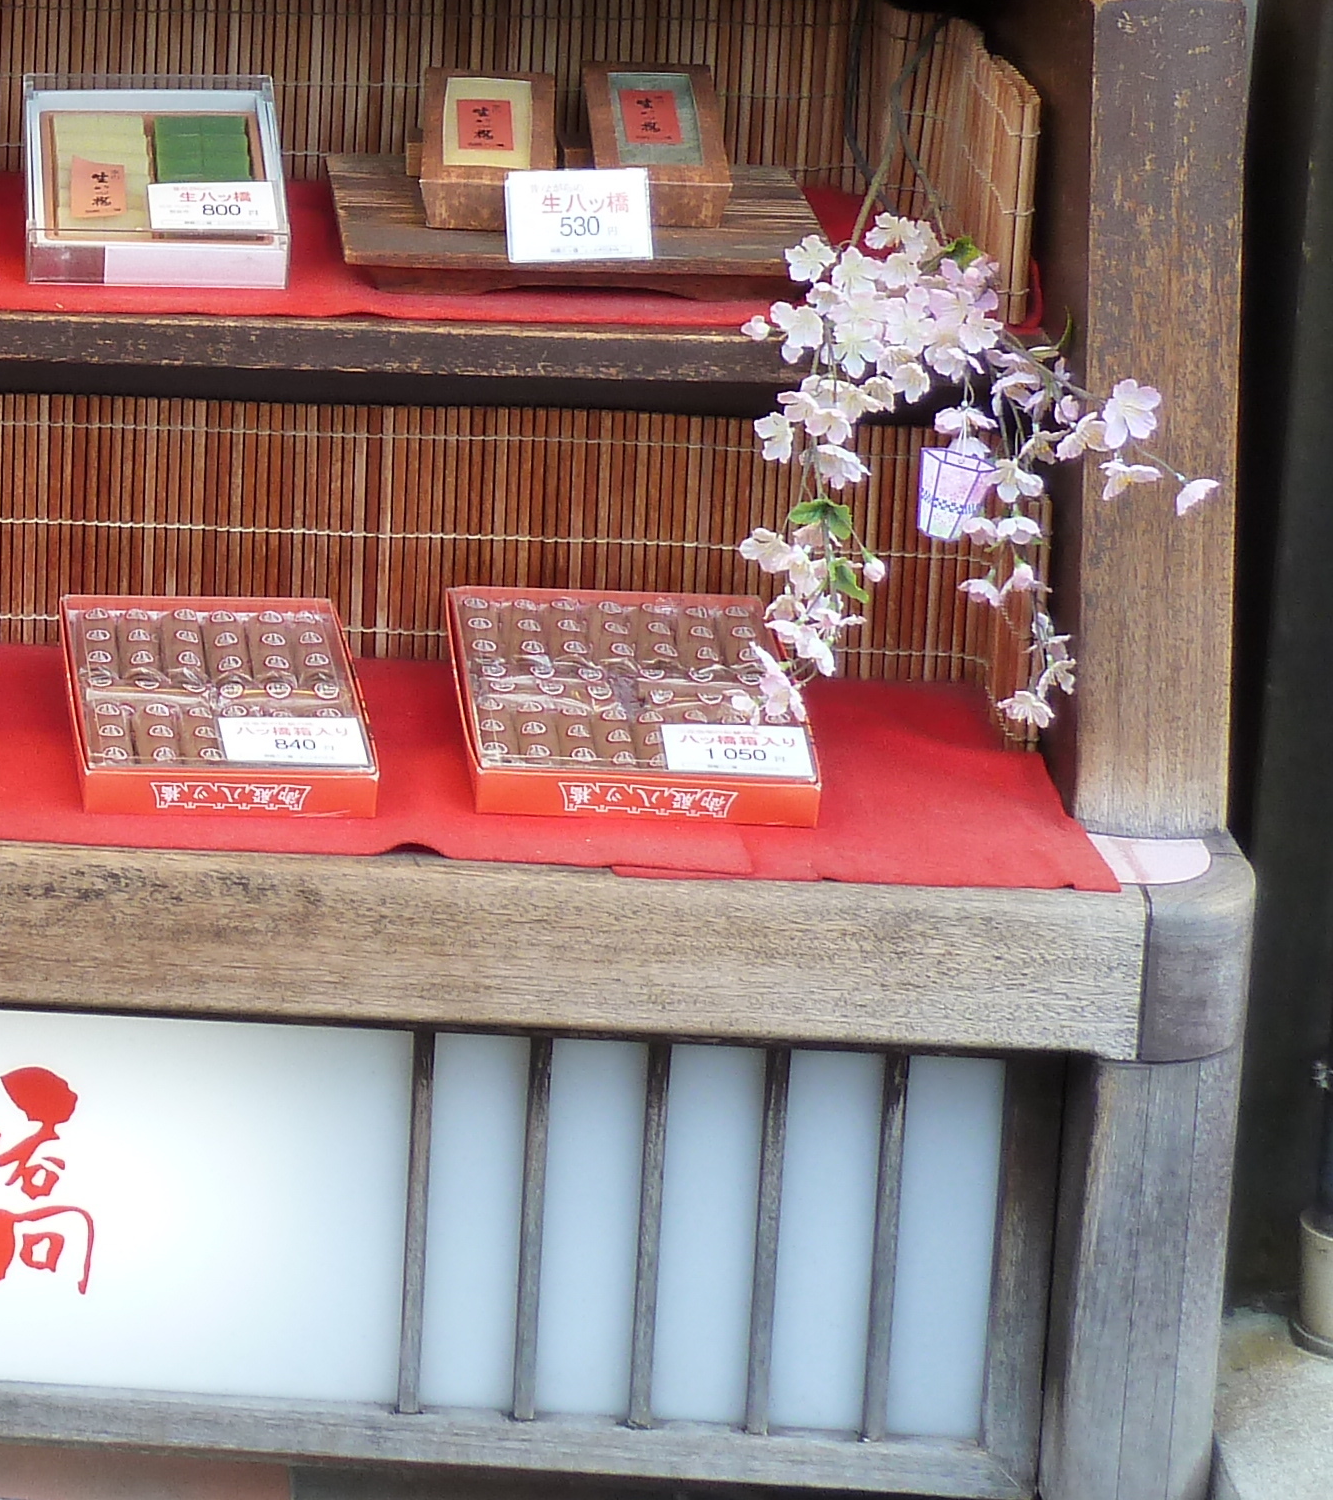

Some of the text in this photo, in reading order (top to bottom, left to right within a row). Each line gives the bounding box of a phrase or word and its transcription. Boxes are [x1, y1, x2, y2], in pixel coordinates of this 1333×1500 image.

[201, 204, 242, 217] 800
[559, 215, 601, 238] 530
[274, 738, 317, 751] 840
